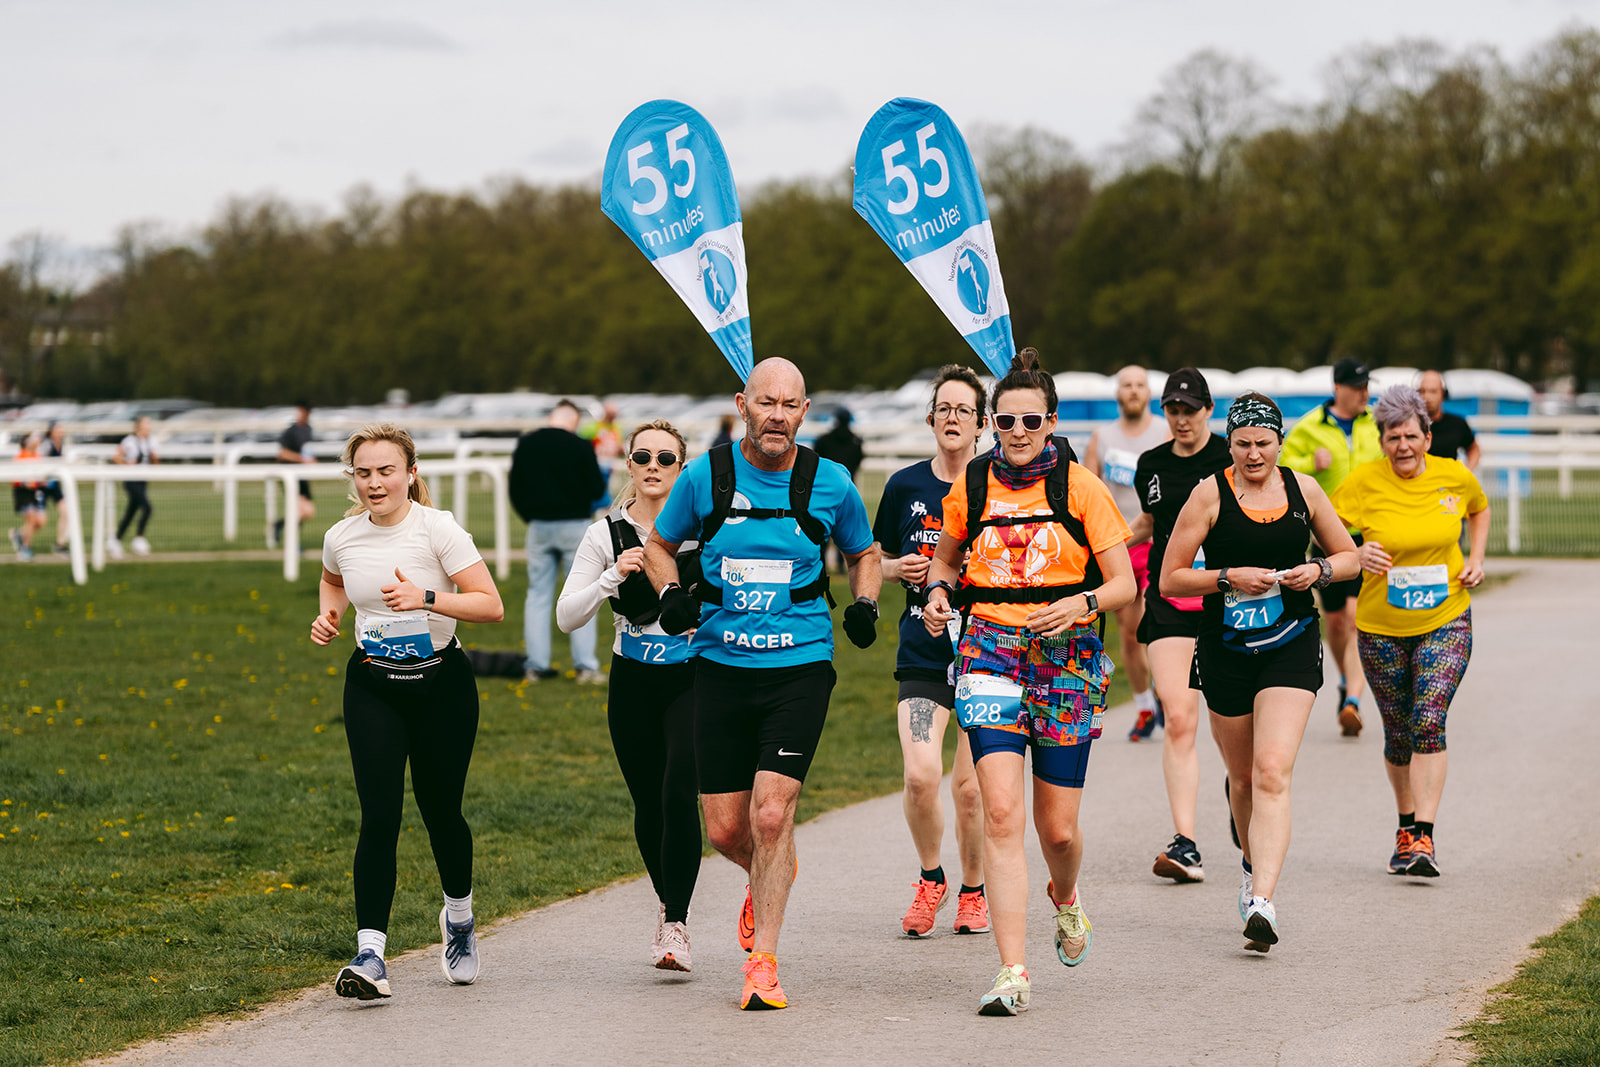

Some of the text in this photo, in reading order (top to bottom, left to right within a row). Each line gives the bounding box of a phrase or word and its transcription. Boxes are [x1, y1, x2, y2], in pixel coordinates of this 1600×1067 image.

[628, 122, 696, 216] 55
[881, 122, 950, 215] 55
[641, 205, 704, 249] minutes
[896, 205, 961, 250] minutes
[726, 571, 745, 582] 10k
[1392, 577, 1408, 586] 10k
[734, 590, 777, 611] 327
[1225, 594, 1238, 604] 0k
[1402, 590, 1436, 608] 124
[1232, 606, 1269, 628] 271
[364, 630, 384, 639] 10k
[624, 623, 643, 634] 10k
[723, 630, 795, 648] PACER
[641, 642, 666, 662] 72
[958, 686, 972, 697] 10k
[964, 702, 1001, 724] 328
